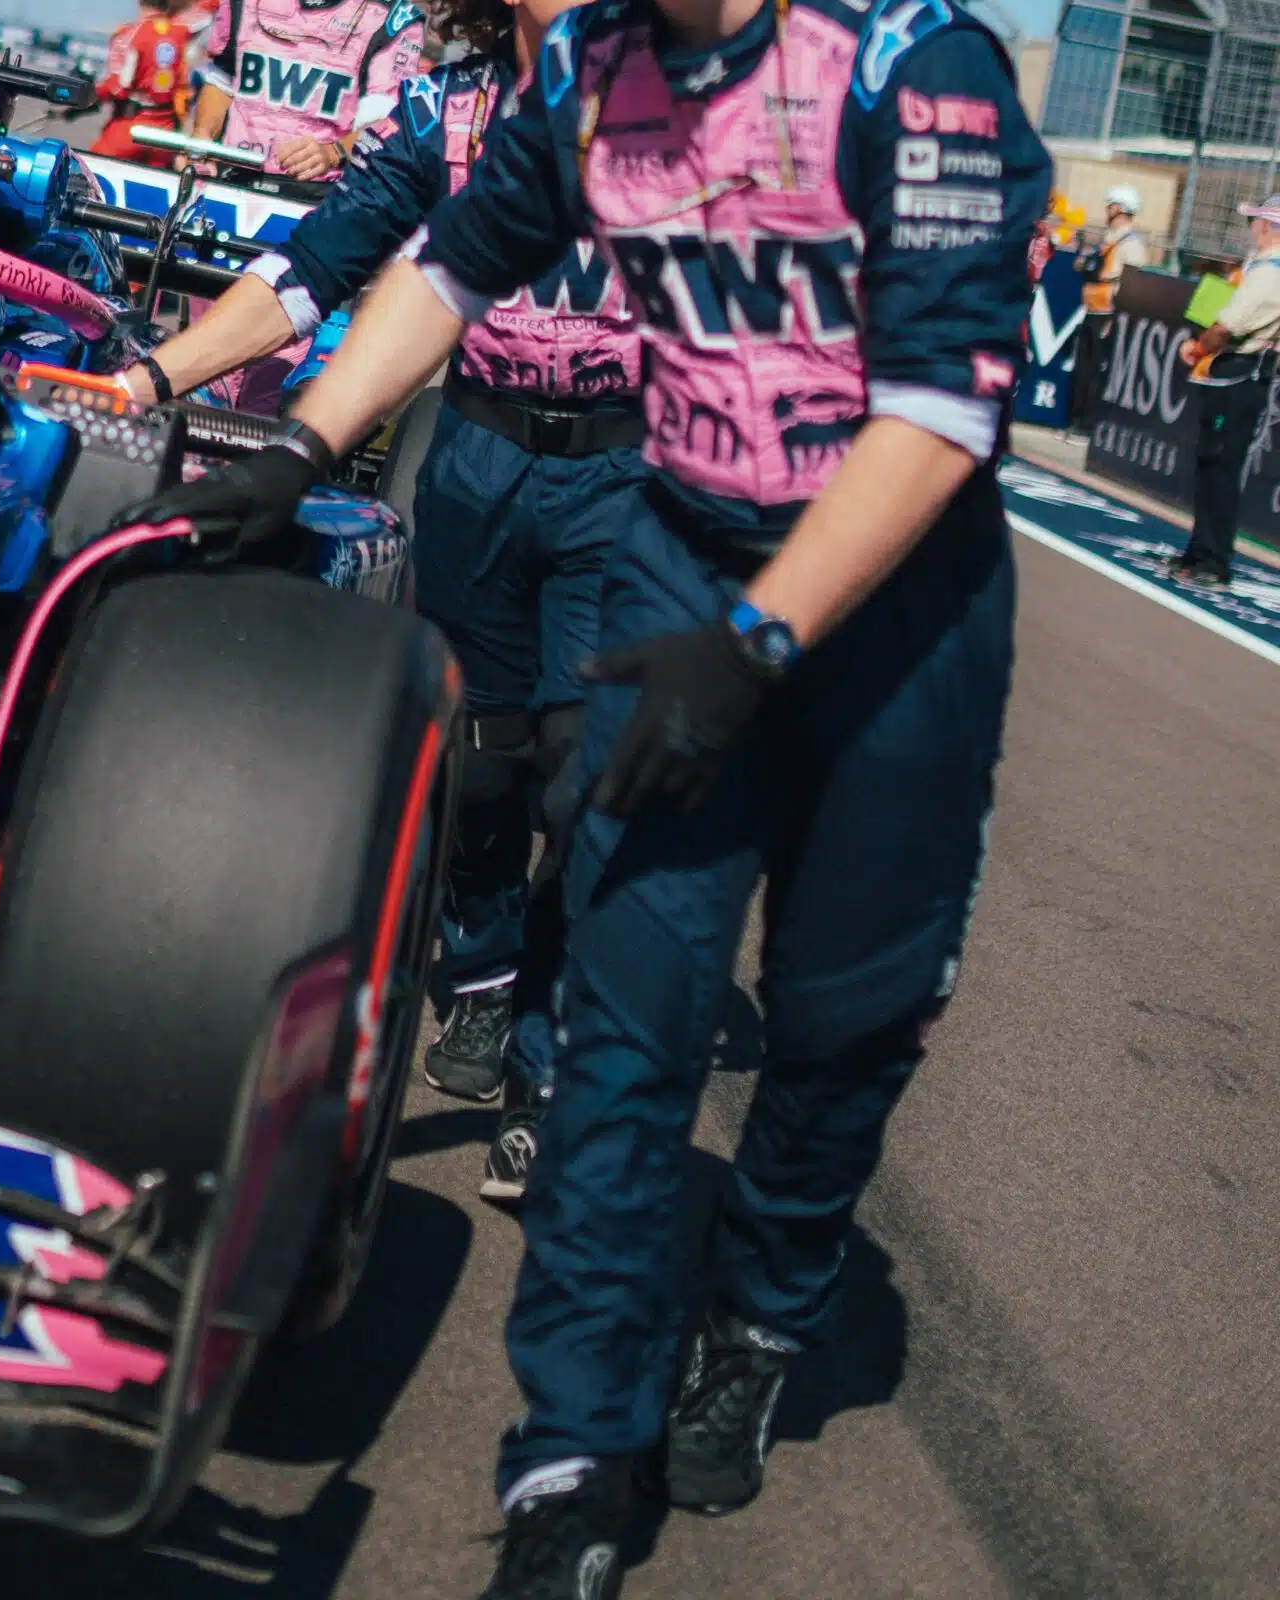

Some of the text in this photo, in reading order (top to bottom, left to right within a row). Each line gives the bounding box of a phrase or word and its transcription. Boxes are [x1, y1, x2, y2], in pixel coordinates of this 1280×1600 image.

[235, 50, 354, 121] BWT
[493, 309, 546, 331] WATER
[602, 224, 867, 348] BWT
[1103, 313, 1192, 424] MSC
